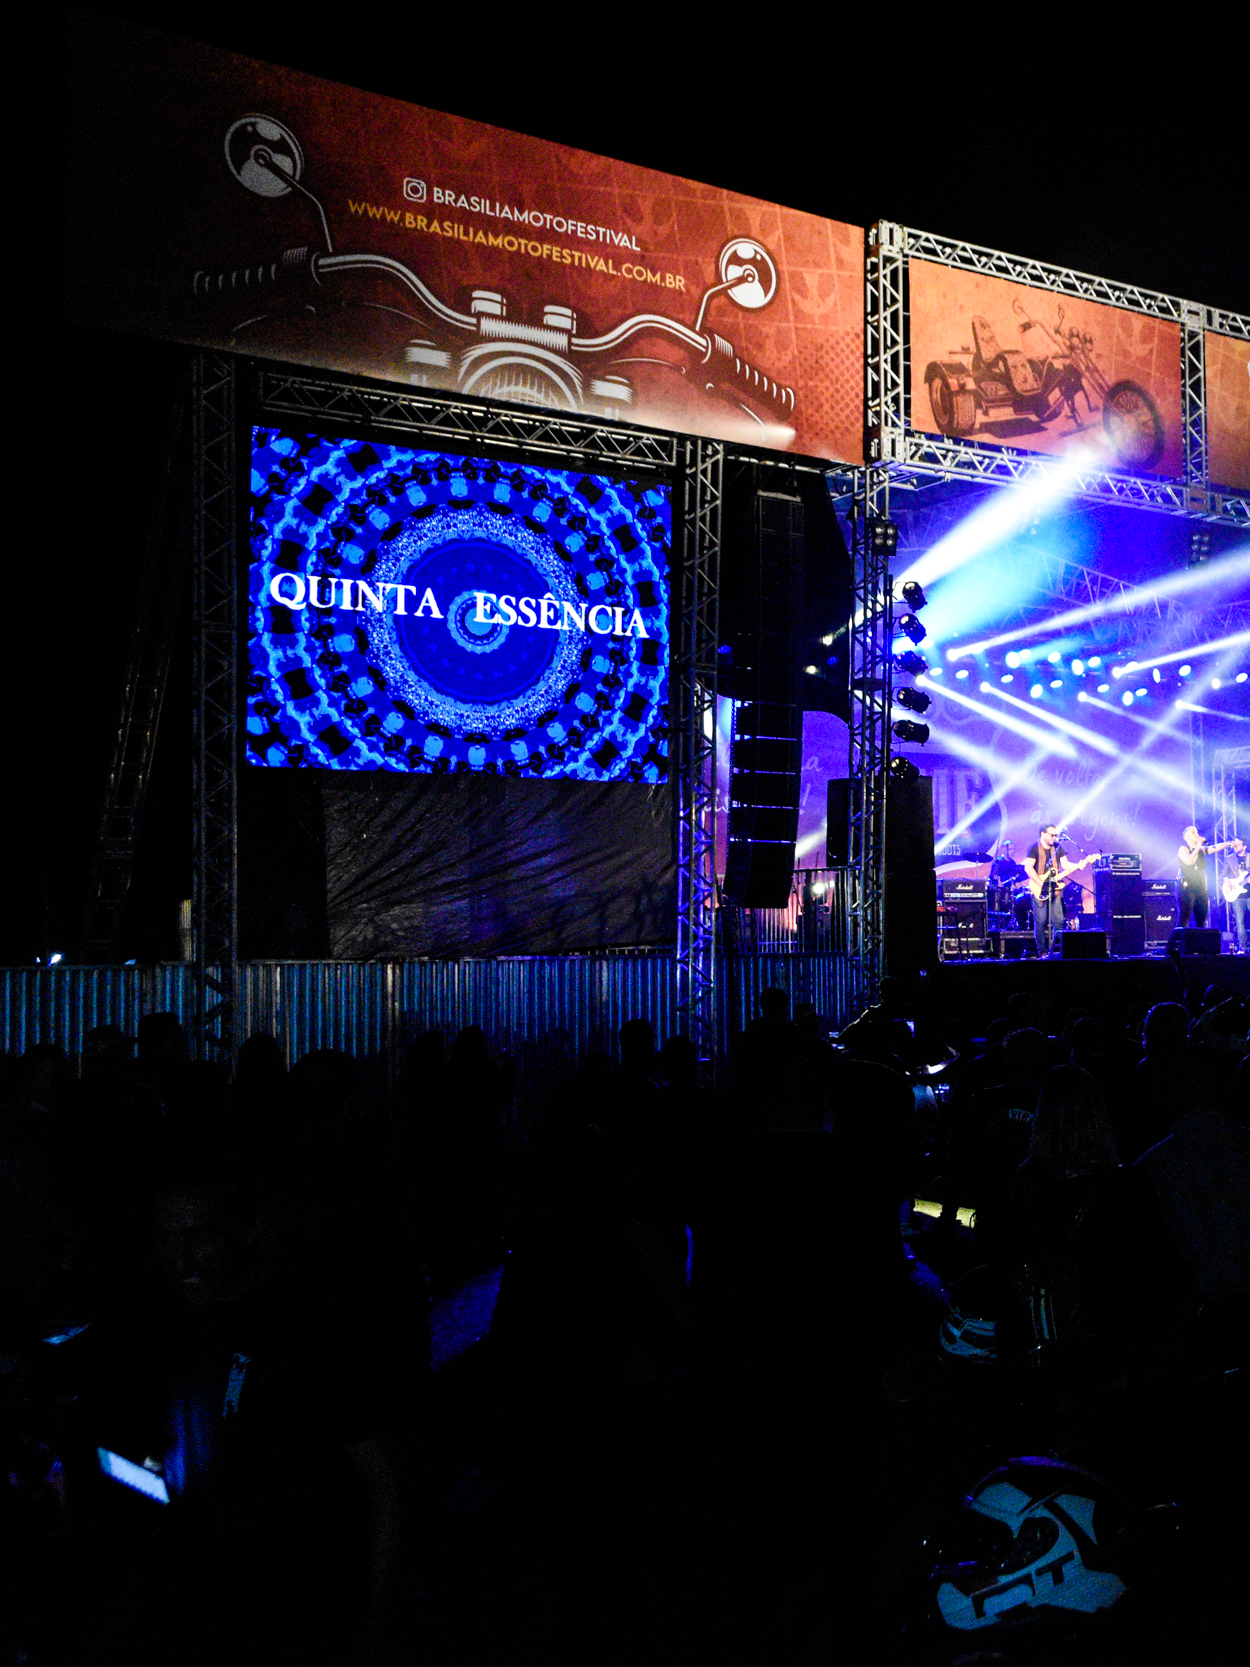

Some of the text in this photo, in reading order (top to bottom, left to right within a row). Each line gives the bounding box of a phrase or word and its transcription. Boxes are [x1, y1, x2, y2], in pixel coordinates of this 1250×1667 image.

[347, 198, 686, 292] WWW.BRASILIAMOTOFESTIVAL.COM.BR
[432, 186, 642, 251] BRASILIAMOTOFESTIVAL
[269, 572, 650, 639] QUINTA ESSÊNCIA
